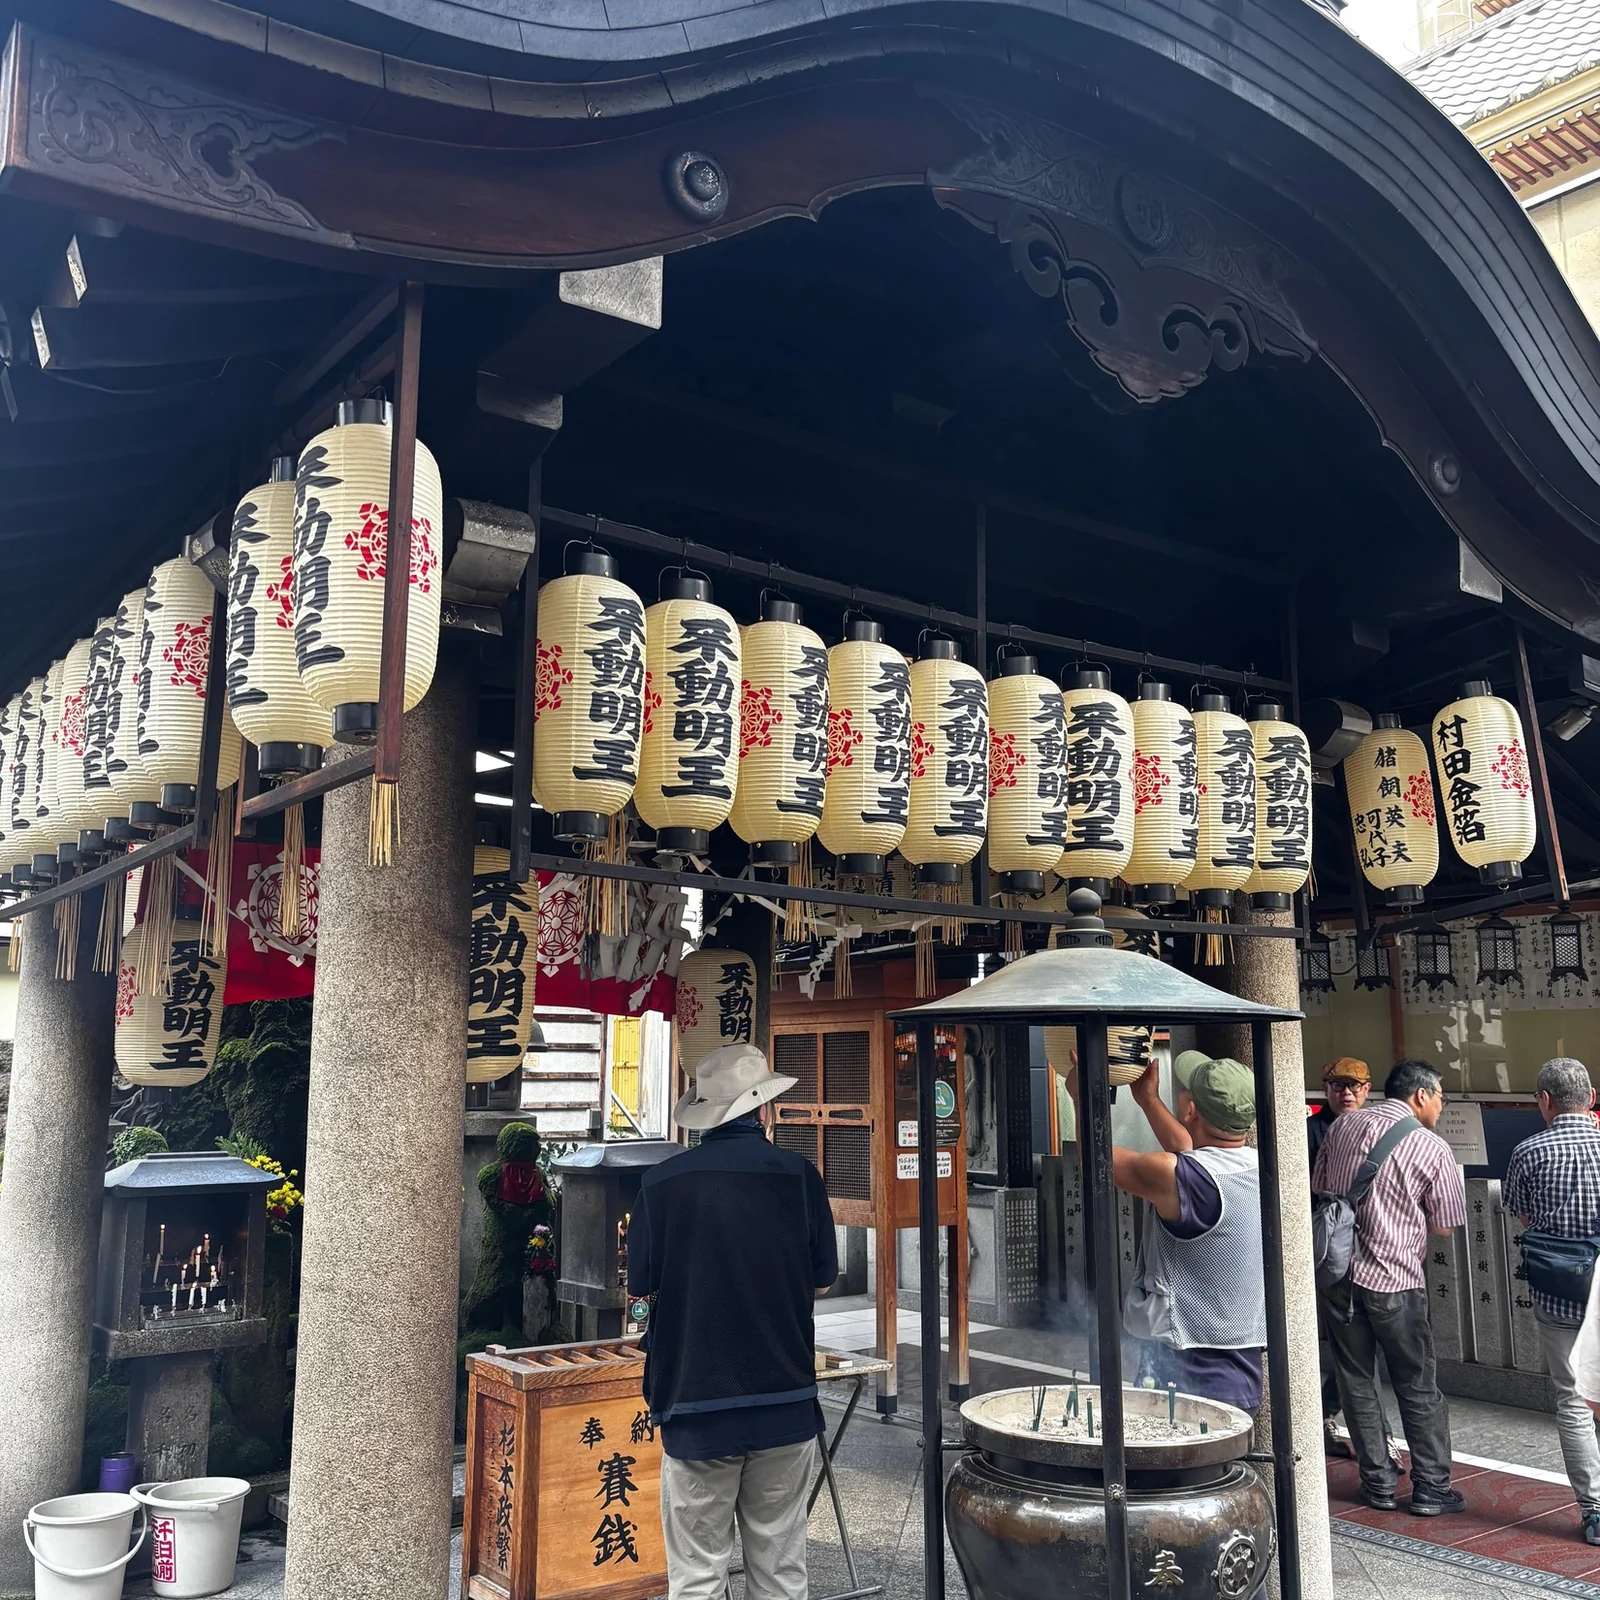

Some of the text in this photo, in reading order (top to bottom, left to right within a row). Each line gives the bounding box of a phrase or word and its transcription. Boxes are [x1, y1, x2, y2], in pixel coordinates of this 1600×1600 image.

[573, 596, 646, 786] 不動明王
[661, 618, 737, 800] 不動明王
[776, 645, 829, 820] 不動明王
[861, 661, 912, 826] 不動明王
[934, 679, 989, 838] 不動明王
[1064, 702, 1127, 852] 不動明王
[1212, 729, 1256, 868] 不動明王
[1257, 735, 1310, 872] 不動明王
[1366, 808, 1391, 868] 可代子
[1437, 714, 1486, 846] 村田金箔
[149, 939, 221, 1070] 不動明王
[468, 870, 532, 1059] 不動明王
[714, 962, 754, 1047] 不動明
[579, 1411, 655, 1450] 奉納
[158, 1521, 173, 1580] 千日前
[590, 1452, 639, 1566] 賽銭
